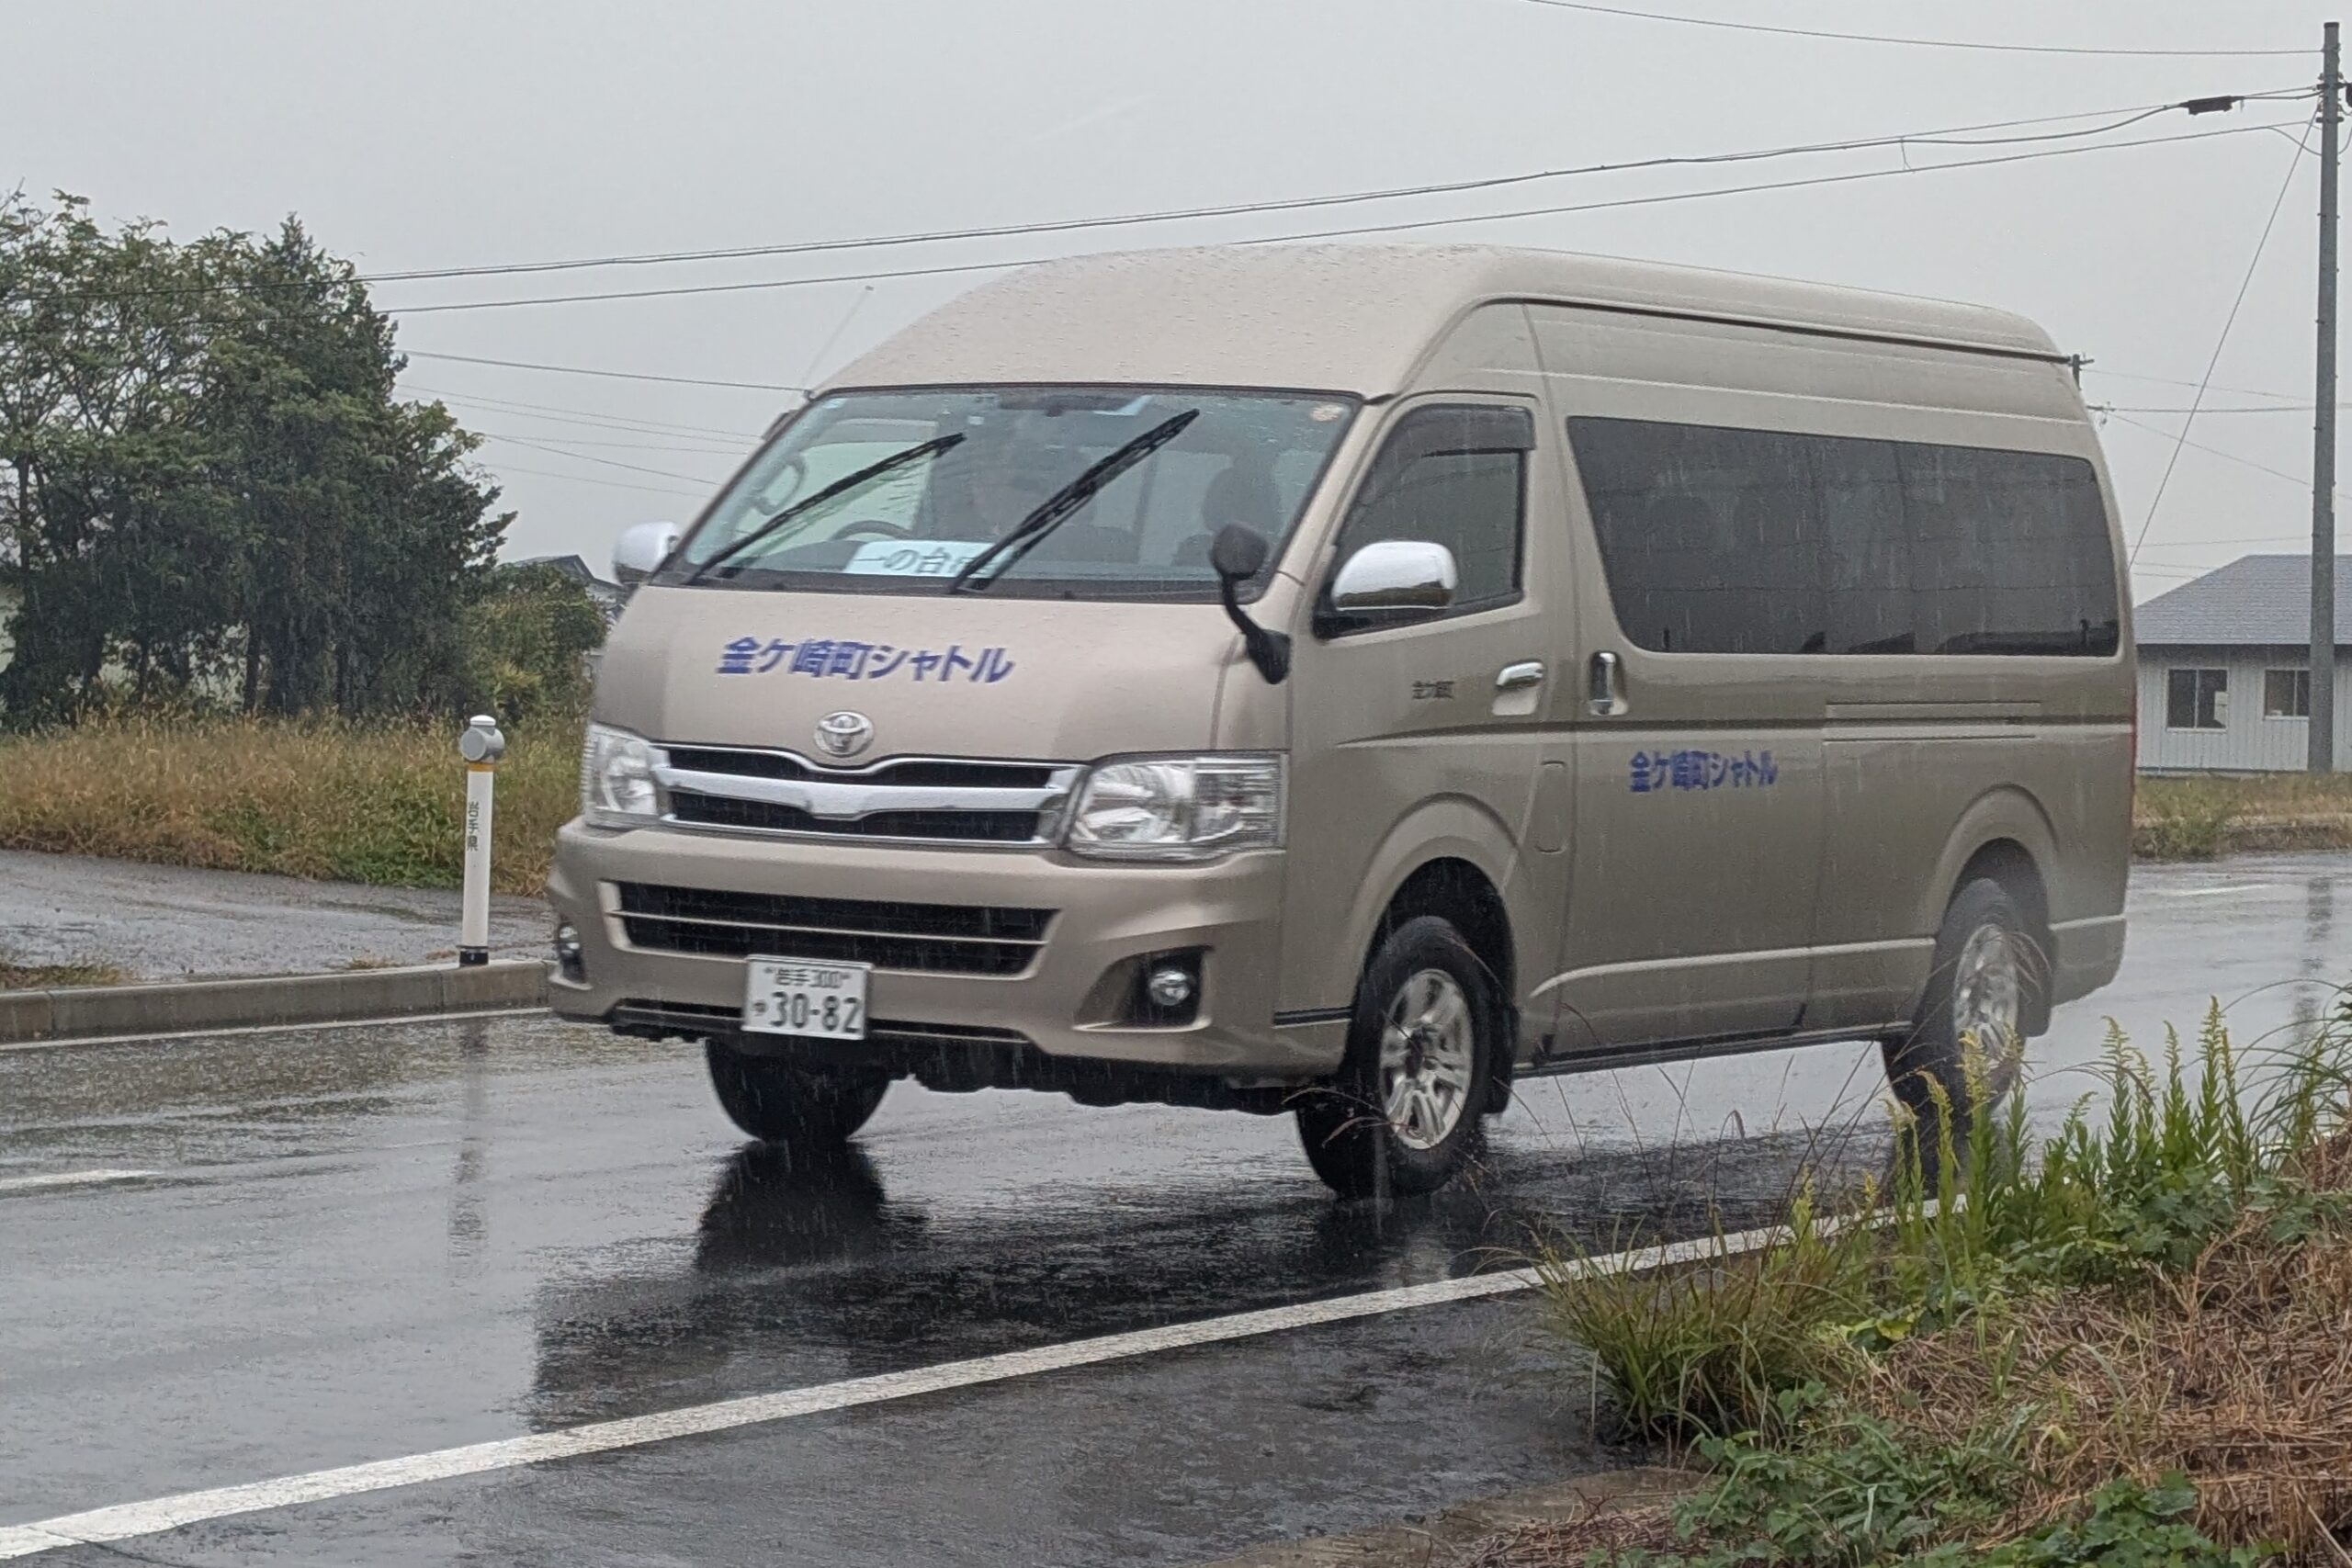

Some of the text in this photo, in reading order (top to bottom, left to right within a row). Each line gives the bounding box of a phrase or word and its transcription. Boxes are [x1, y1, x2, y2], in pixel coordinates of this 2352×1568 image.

[716, 637, 1014, 682] 金ケ崎町シャトル
[1631, 750, 1779, 792] 金ケ崎町シャトル
[467, 801, 480, 852] 岩手県
[770, 991, 860, 1033] 30-82
